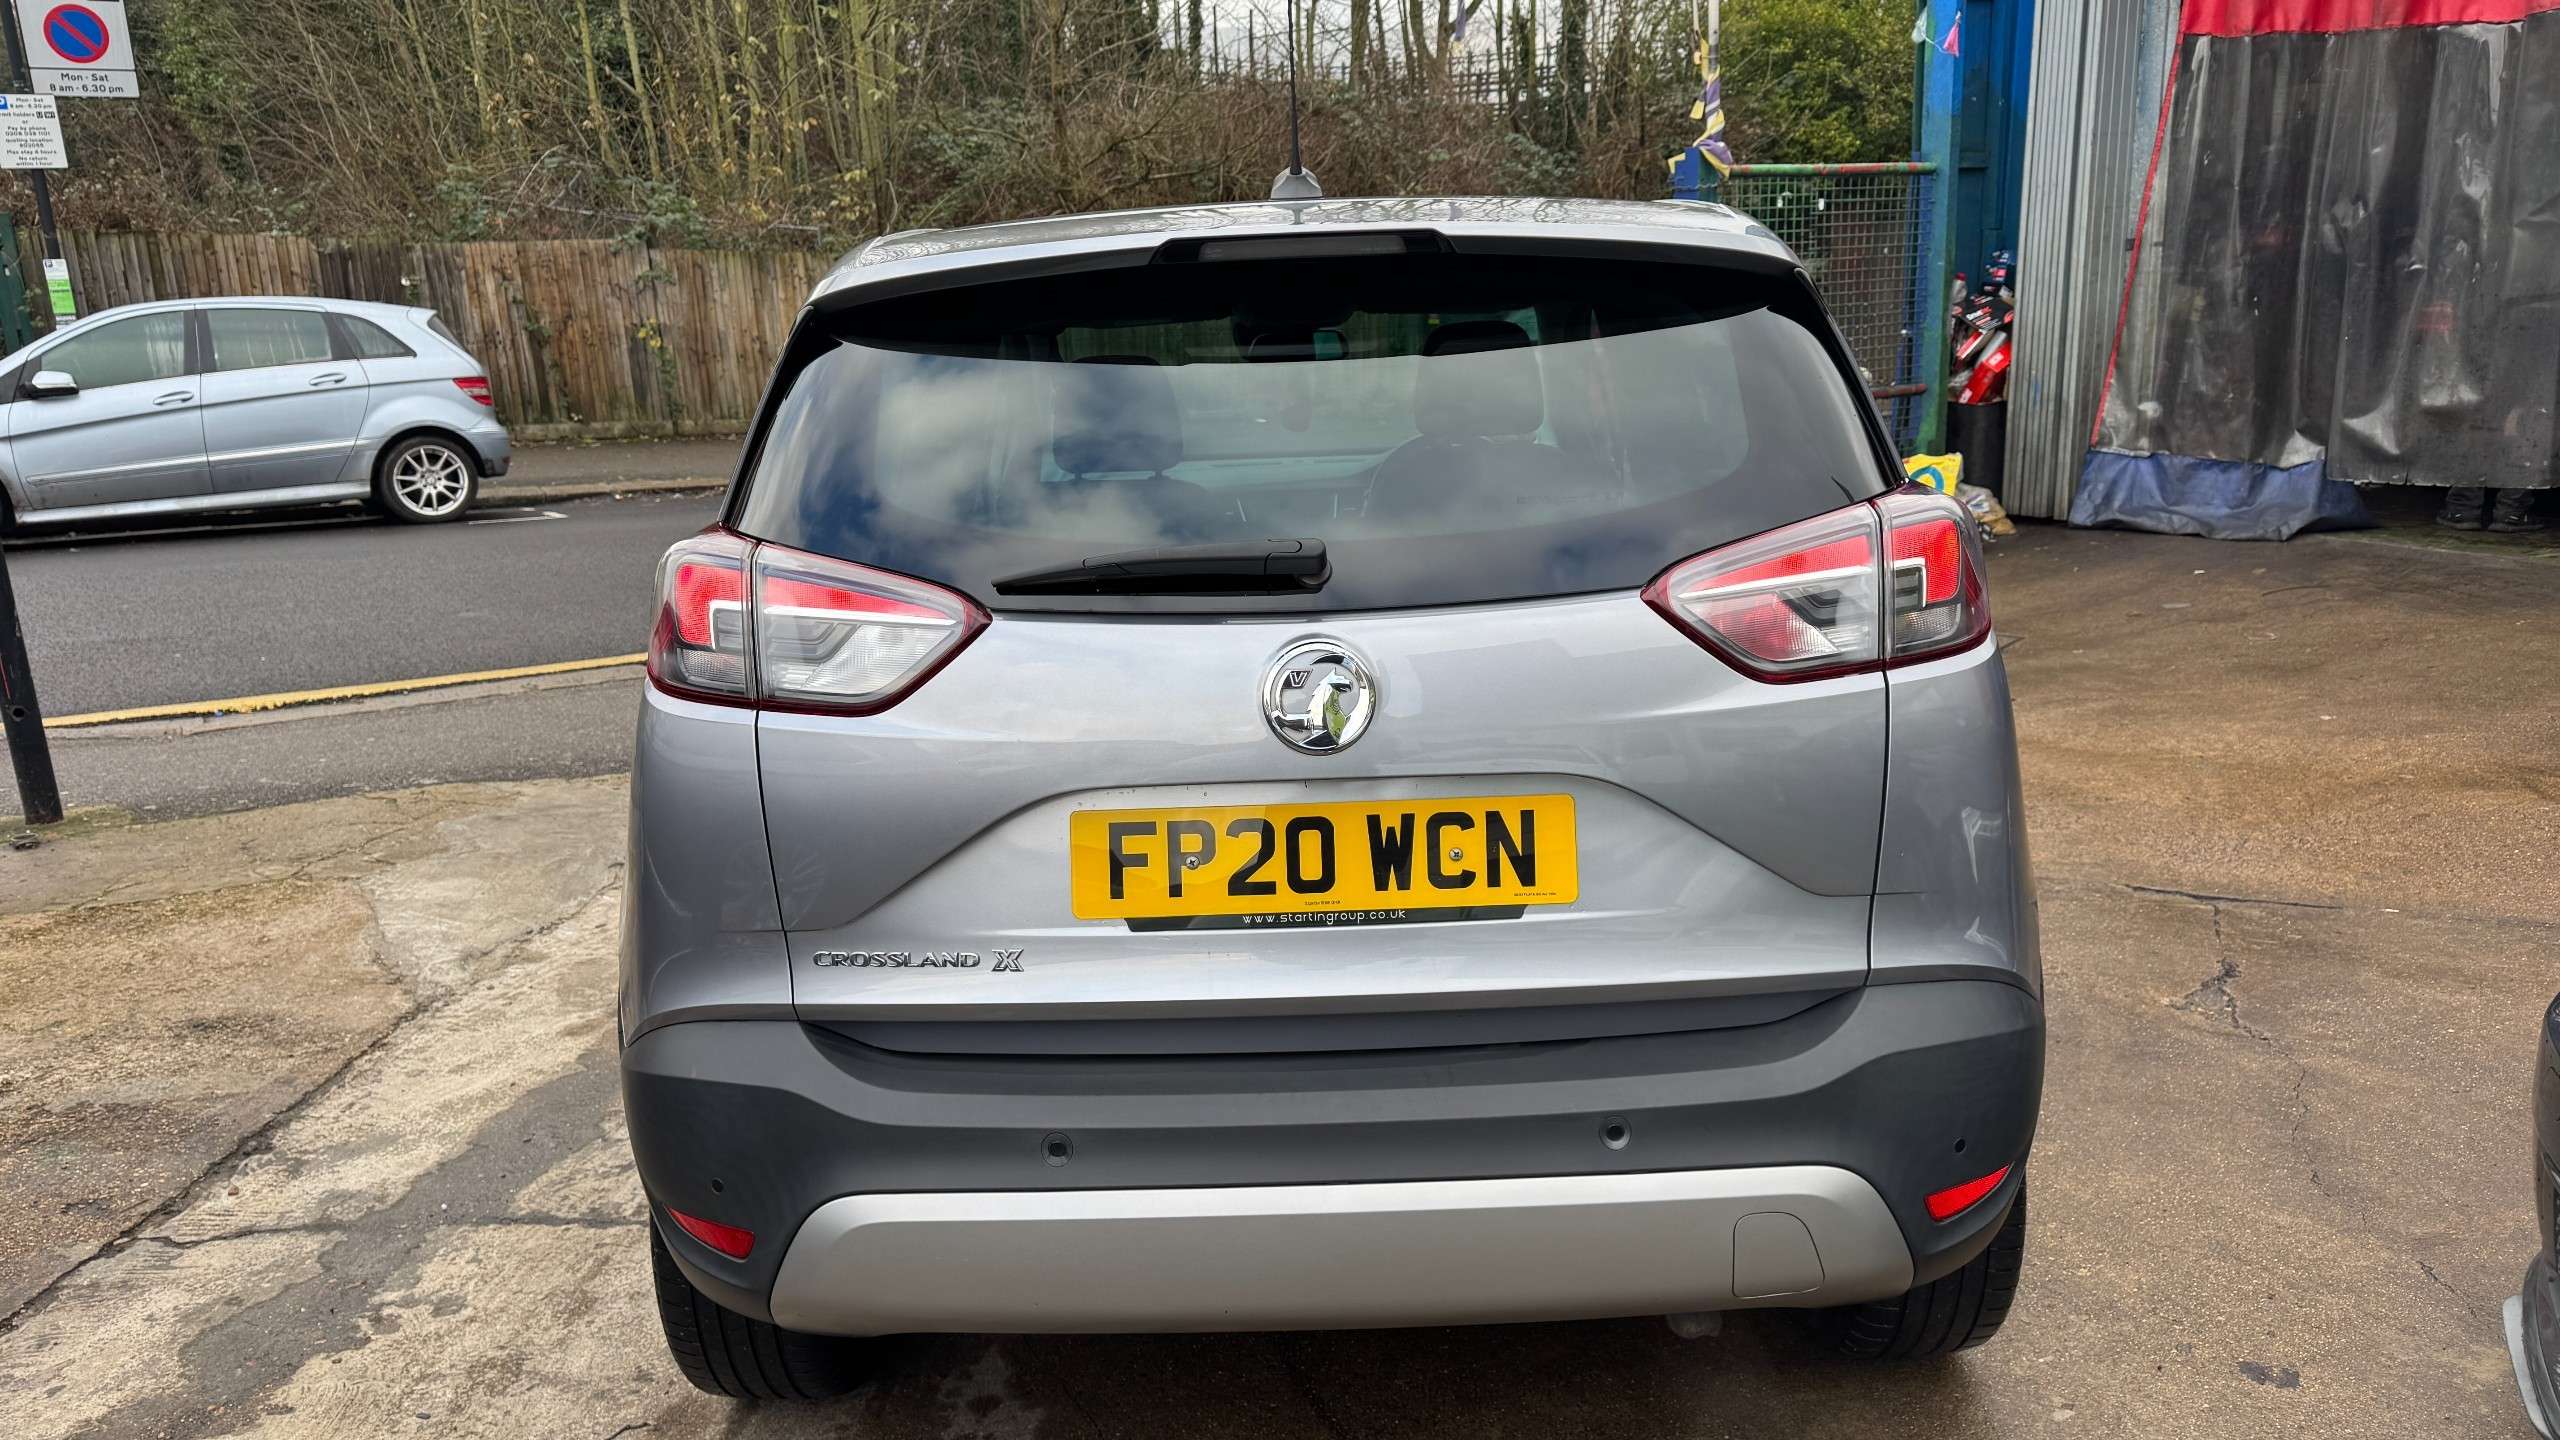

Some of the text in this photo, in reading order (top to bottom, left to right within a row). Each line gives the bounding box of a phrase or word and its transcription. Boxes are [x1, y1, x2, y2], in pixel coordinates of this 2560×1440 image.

[60, 72, 83, 81] Mon
[91, 73, 109, 82] Sat
[49, 83, 57, 92] 8
[82, 84, 106, 93] 6.30
[108, 86, 124, 94] pm
[1108, 808, 1537, 900] FP20 WCN
[1242, 908, 1407, 925] www.startingroup.co.uk
[812, 948, 1025, 972] CROSSLAND X
